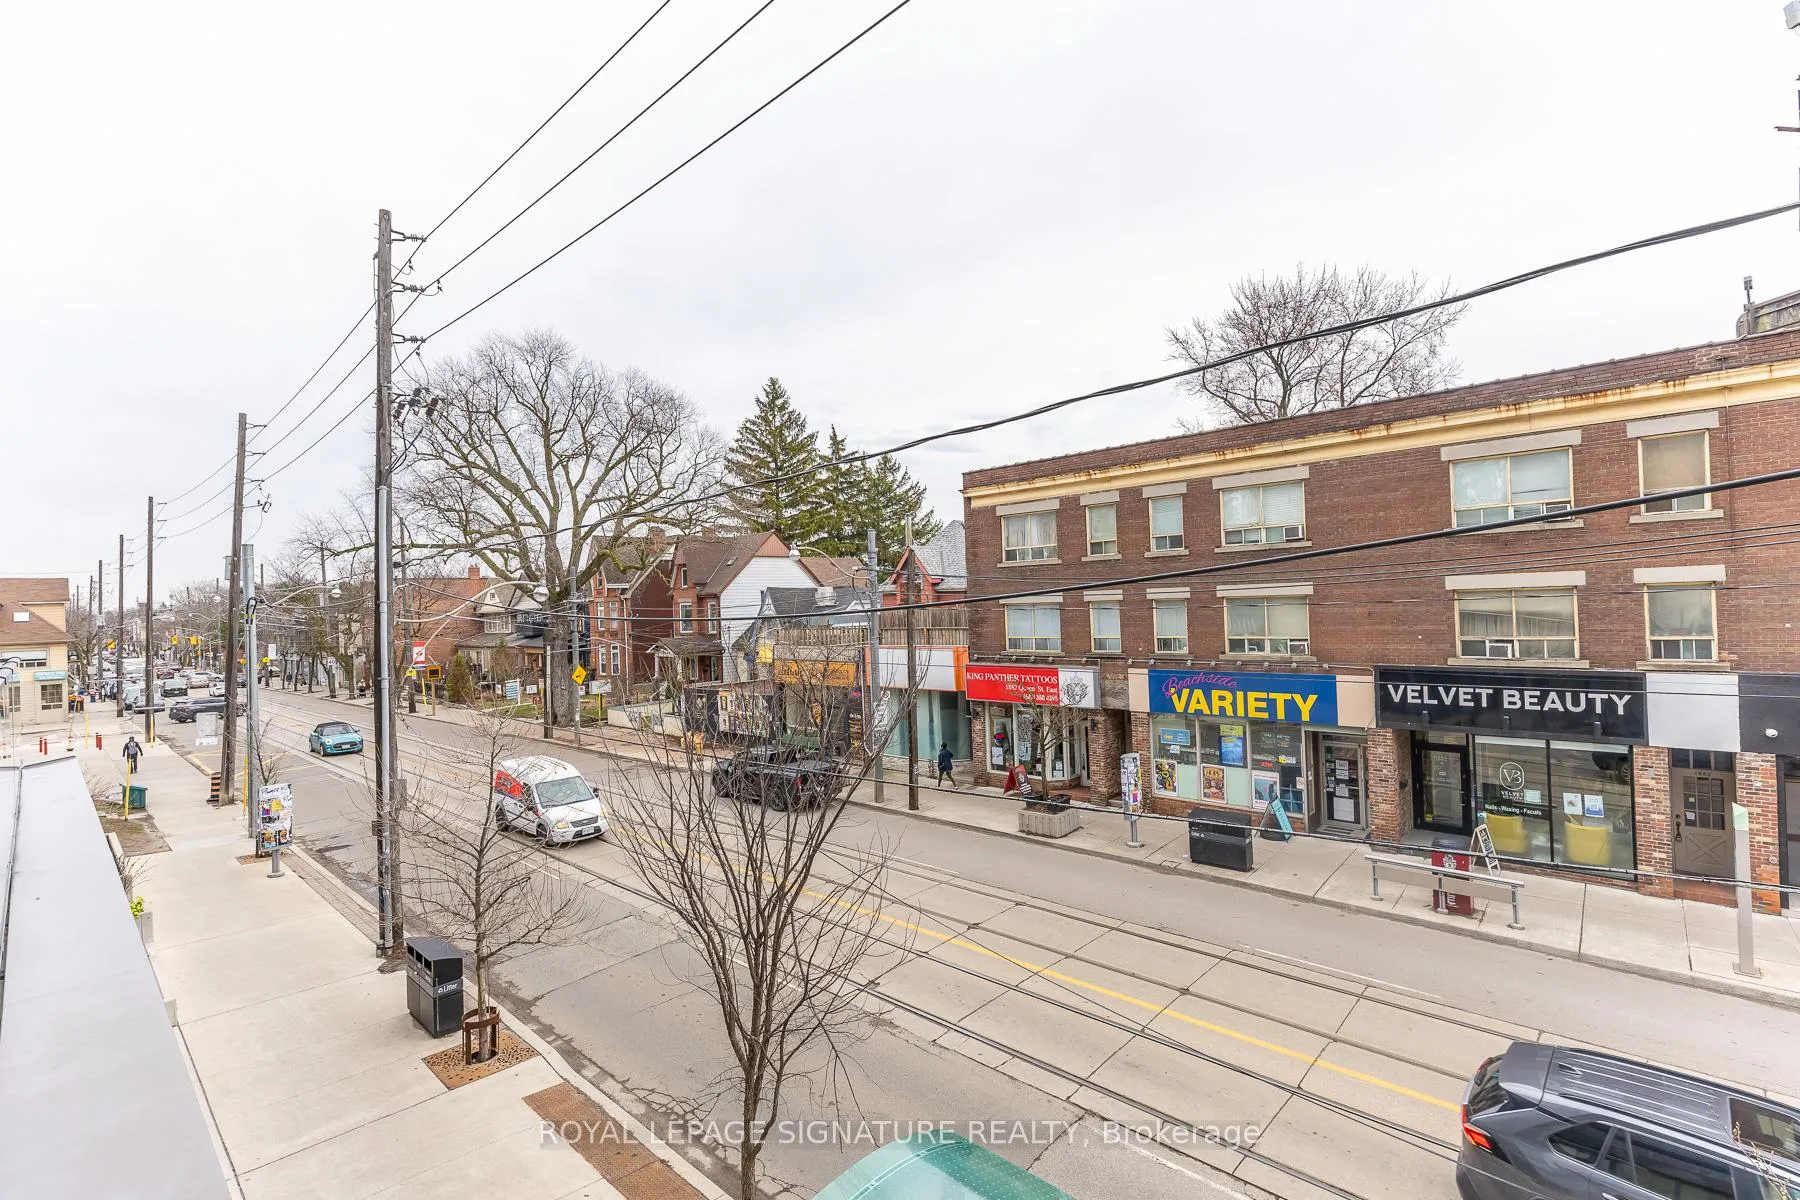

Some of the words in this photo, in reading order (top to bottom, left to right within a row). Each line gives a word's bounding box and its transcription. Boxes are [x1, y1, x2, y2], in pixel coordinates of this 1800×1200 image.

[966, 672, 984, 680] KING
[985, 673, 1019, 682] PANTHER
[1020, 674, 1058, 684] TATTOOS
[1162, 673, 1238, 698] Beachside
[1170, 687, 1319, 722] VARIETY
[1387, 684, 1493, 708] VELVET
[1502, 689, 1632, 715] BEAUTY
[1484, 803, 1498, 811] Nails
[1500, 805, 1520, 814] Waxing
[443, 984, 458, 992] Litter
